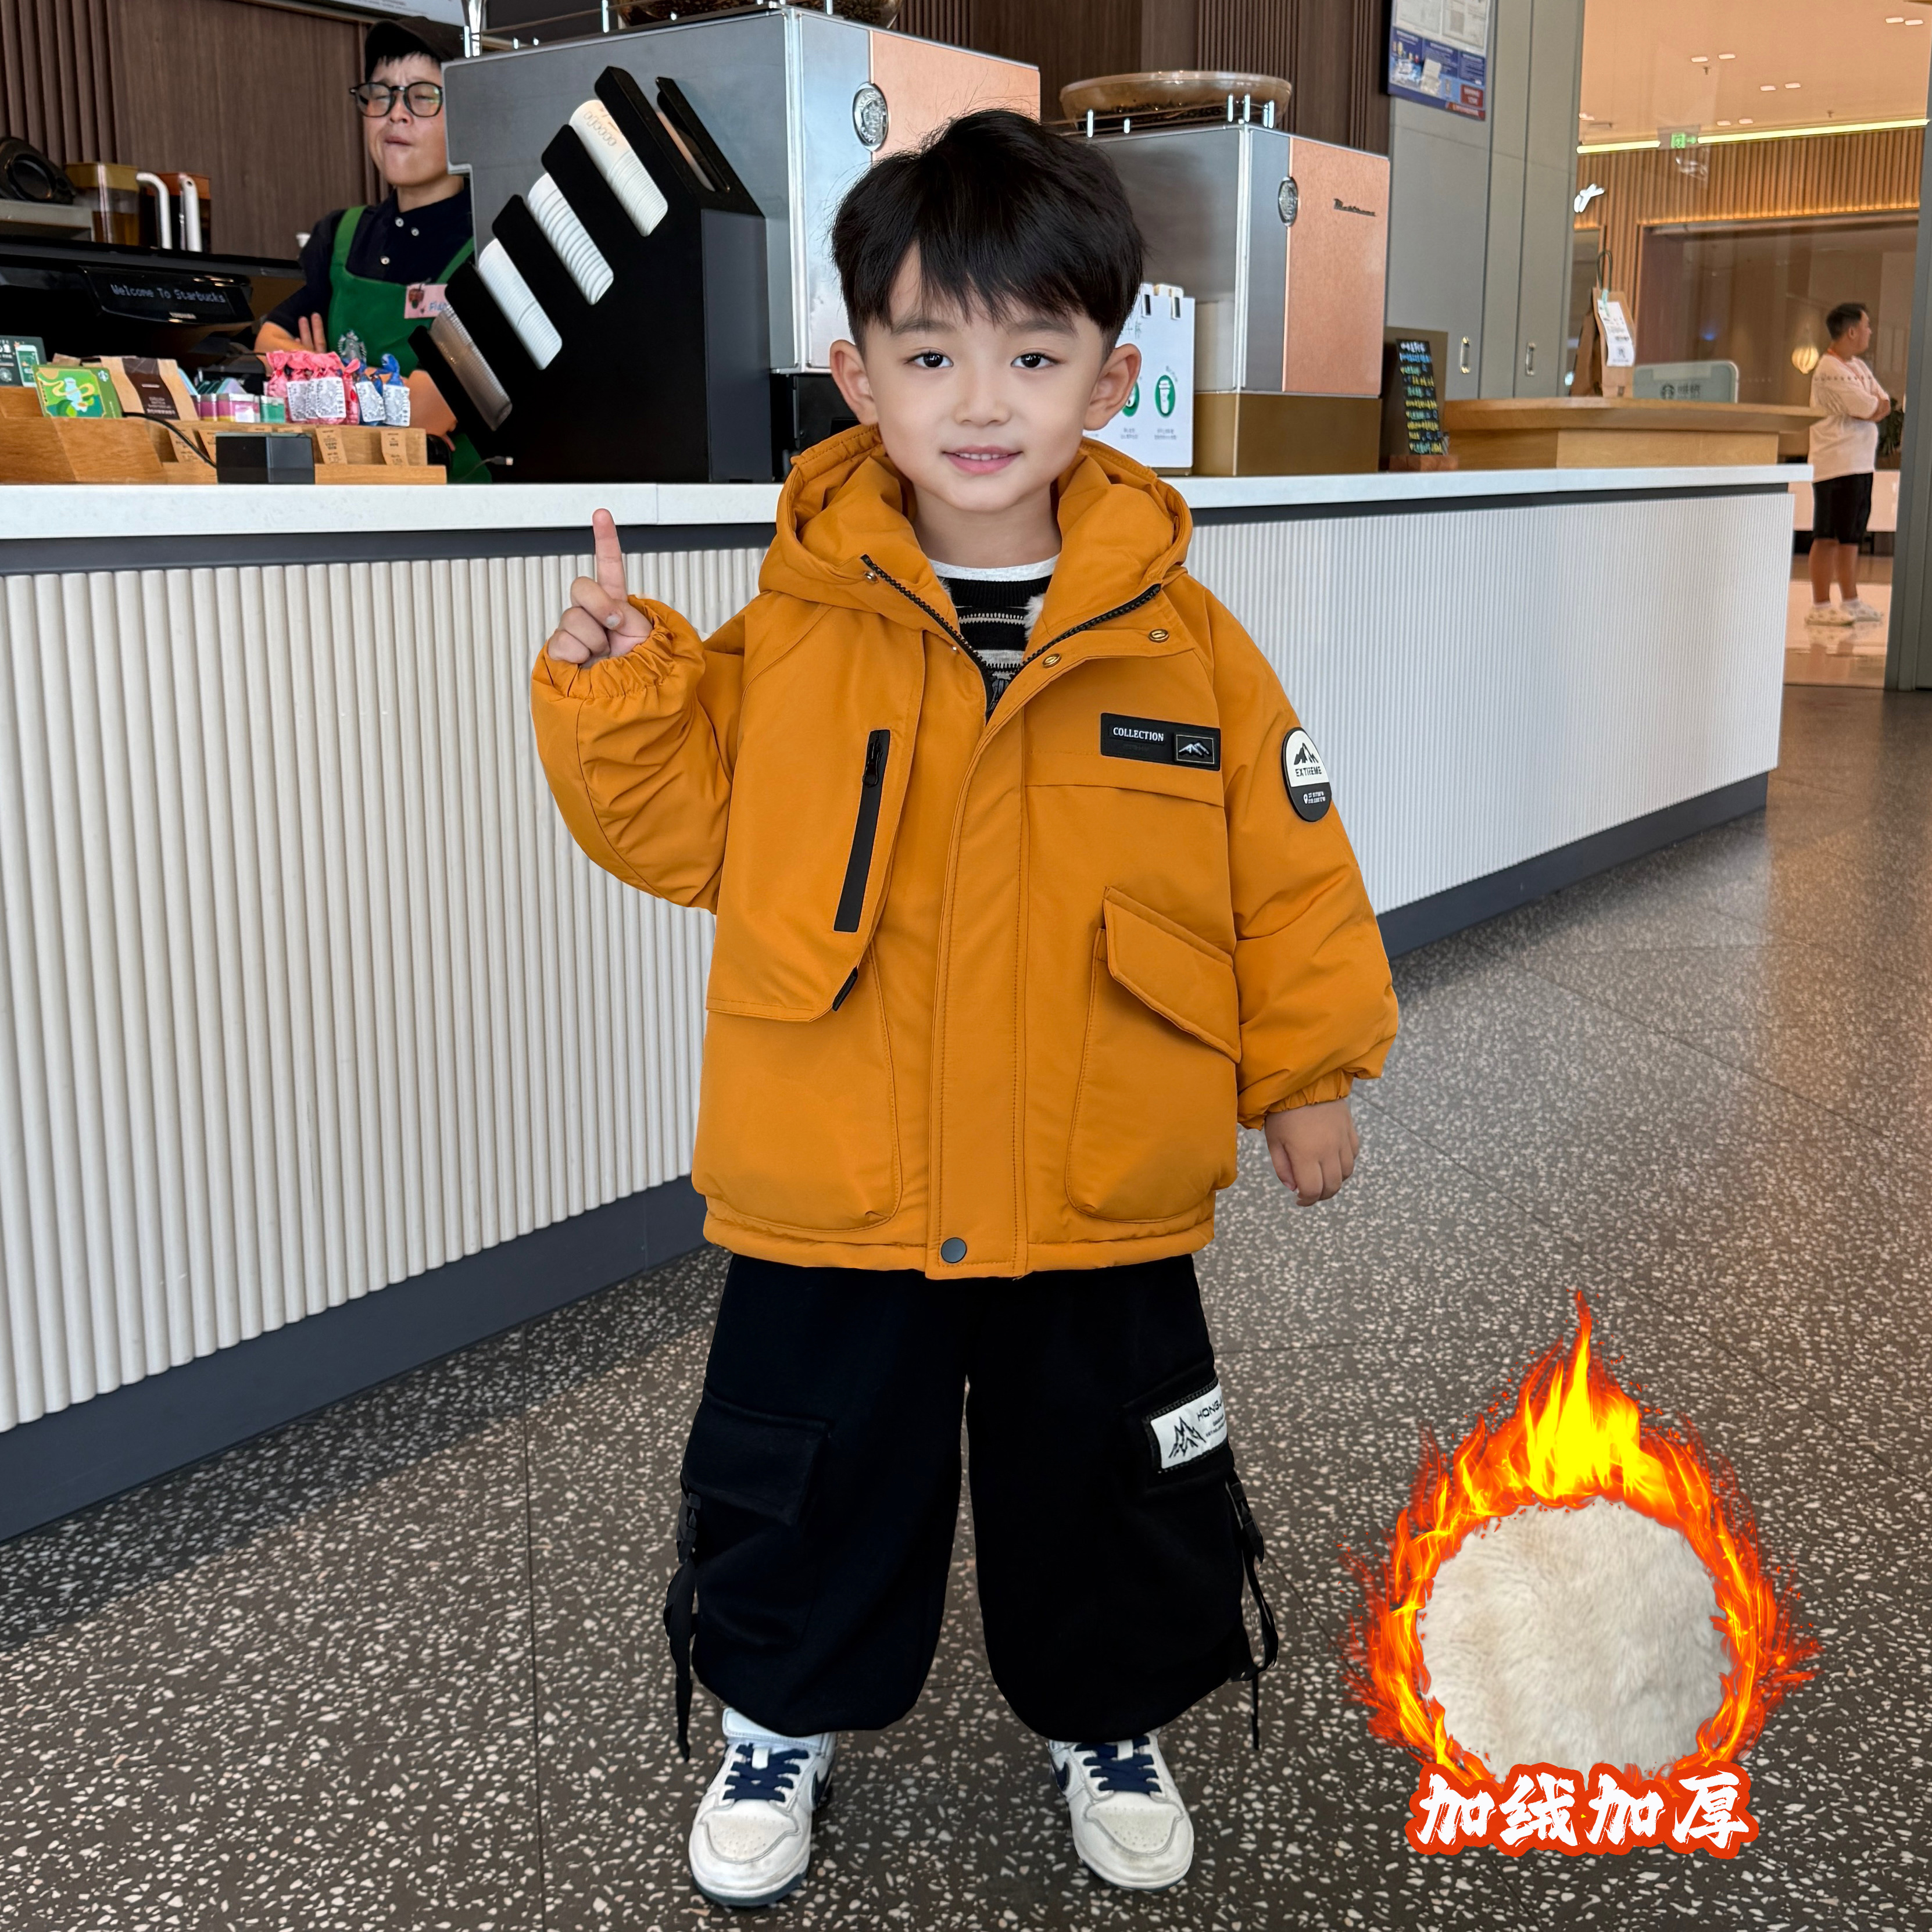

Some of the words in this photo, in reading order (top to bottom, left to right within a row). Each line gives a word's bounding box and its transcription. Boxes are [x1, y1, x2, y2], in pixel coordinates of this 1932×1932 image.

[110, 283, 154, 298] Welcome
[157, 287, 171, 299] To
[174, 289, 226, 303] Starbucks
[1113, 727, 1164, 741] COLLECTION
[1295, 766, 1322, 777] EXTREME
